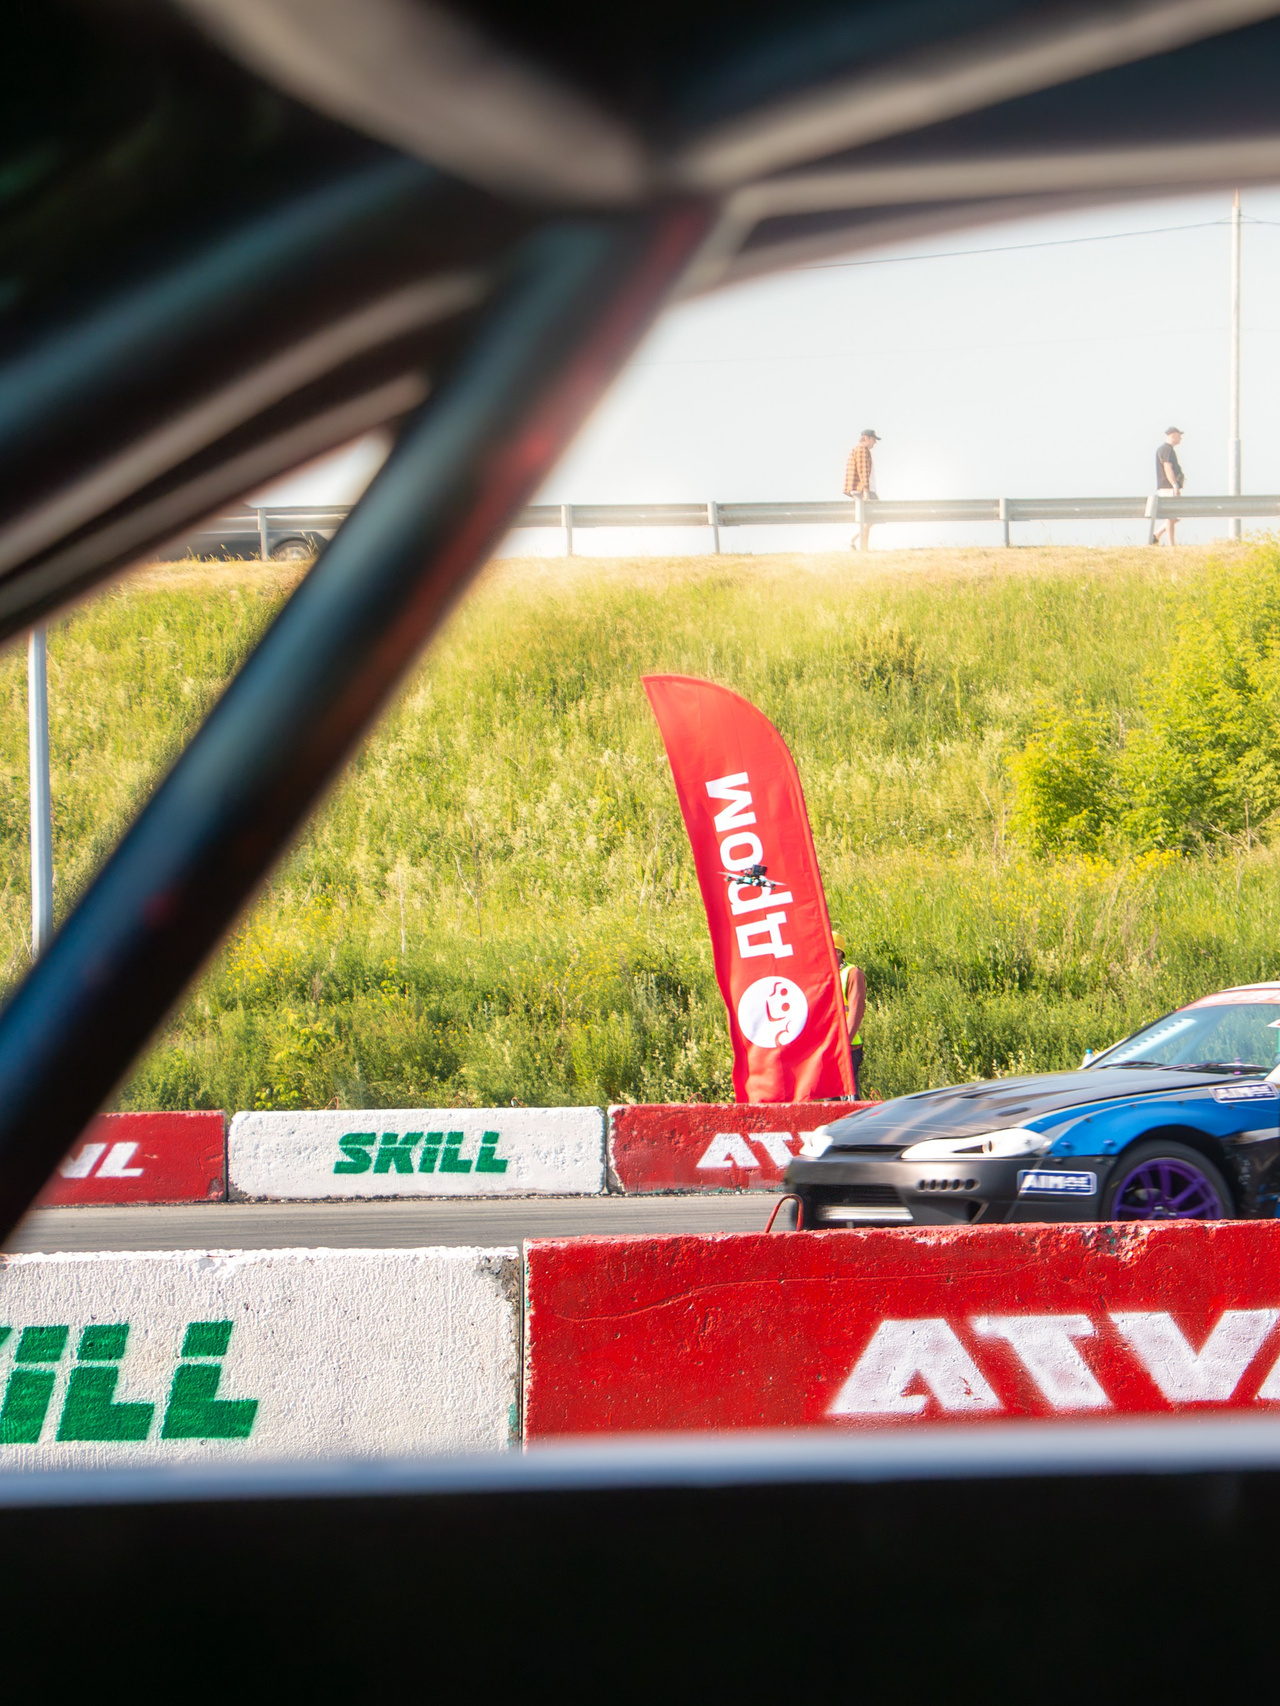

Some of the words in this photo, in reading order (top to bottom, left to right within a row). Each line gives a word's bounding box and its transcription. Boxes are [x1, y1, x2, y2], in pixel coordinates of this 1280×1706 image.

[58, 1142, 144, 1178] VL
[333, 1131, 509, 1175] SKILL
[0, 1320, 259, 1444] ILL
